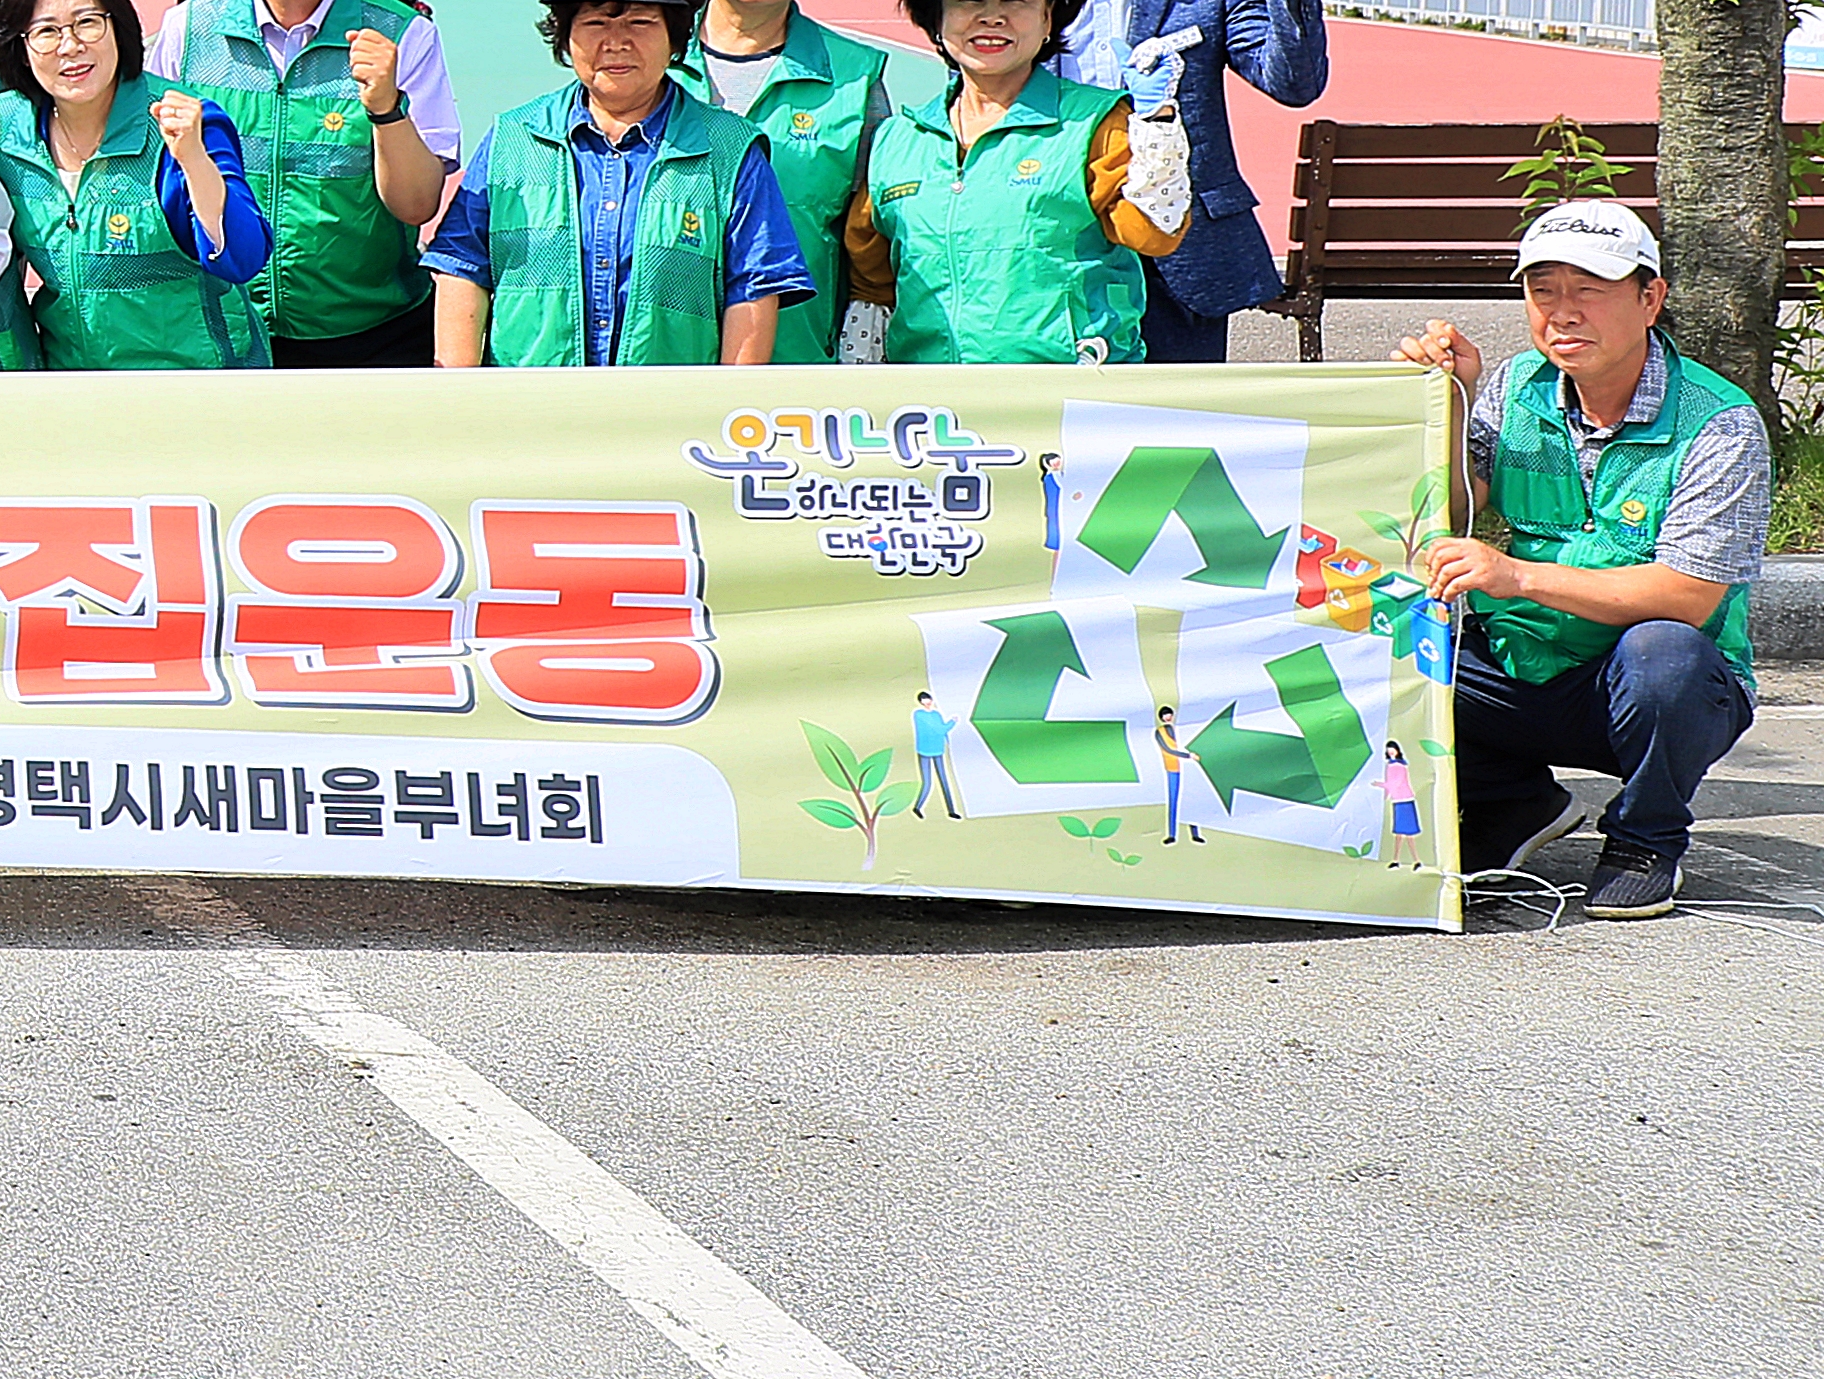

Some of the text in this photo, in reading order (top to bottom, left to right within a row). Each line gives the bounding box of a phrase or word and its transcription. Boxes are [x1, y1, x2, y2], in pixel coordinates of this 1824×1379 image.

[1009, 176, 1041, 187] SMU
[1529, 217, 1624, 240] Titleist
[688, 411, 1016, 513] 온기나눔
[795, 478, 934, 523] 하나되는
[825, 523, 975, 568] 대한민국
